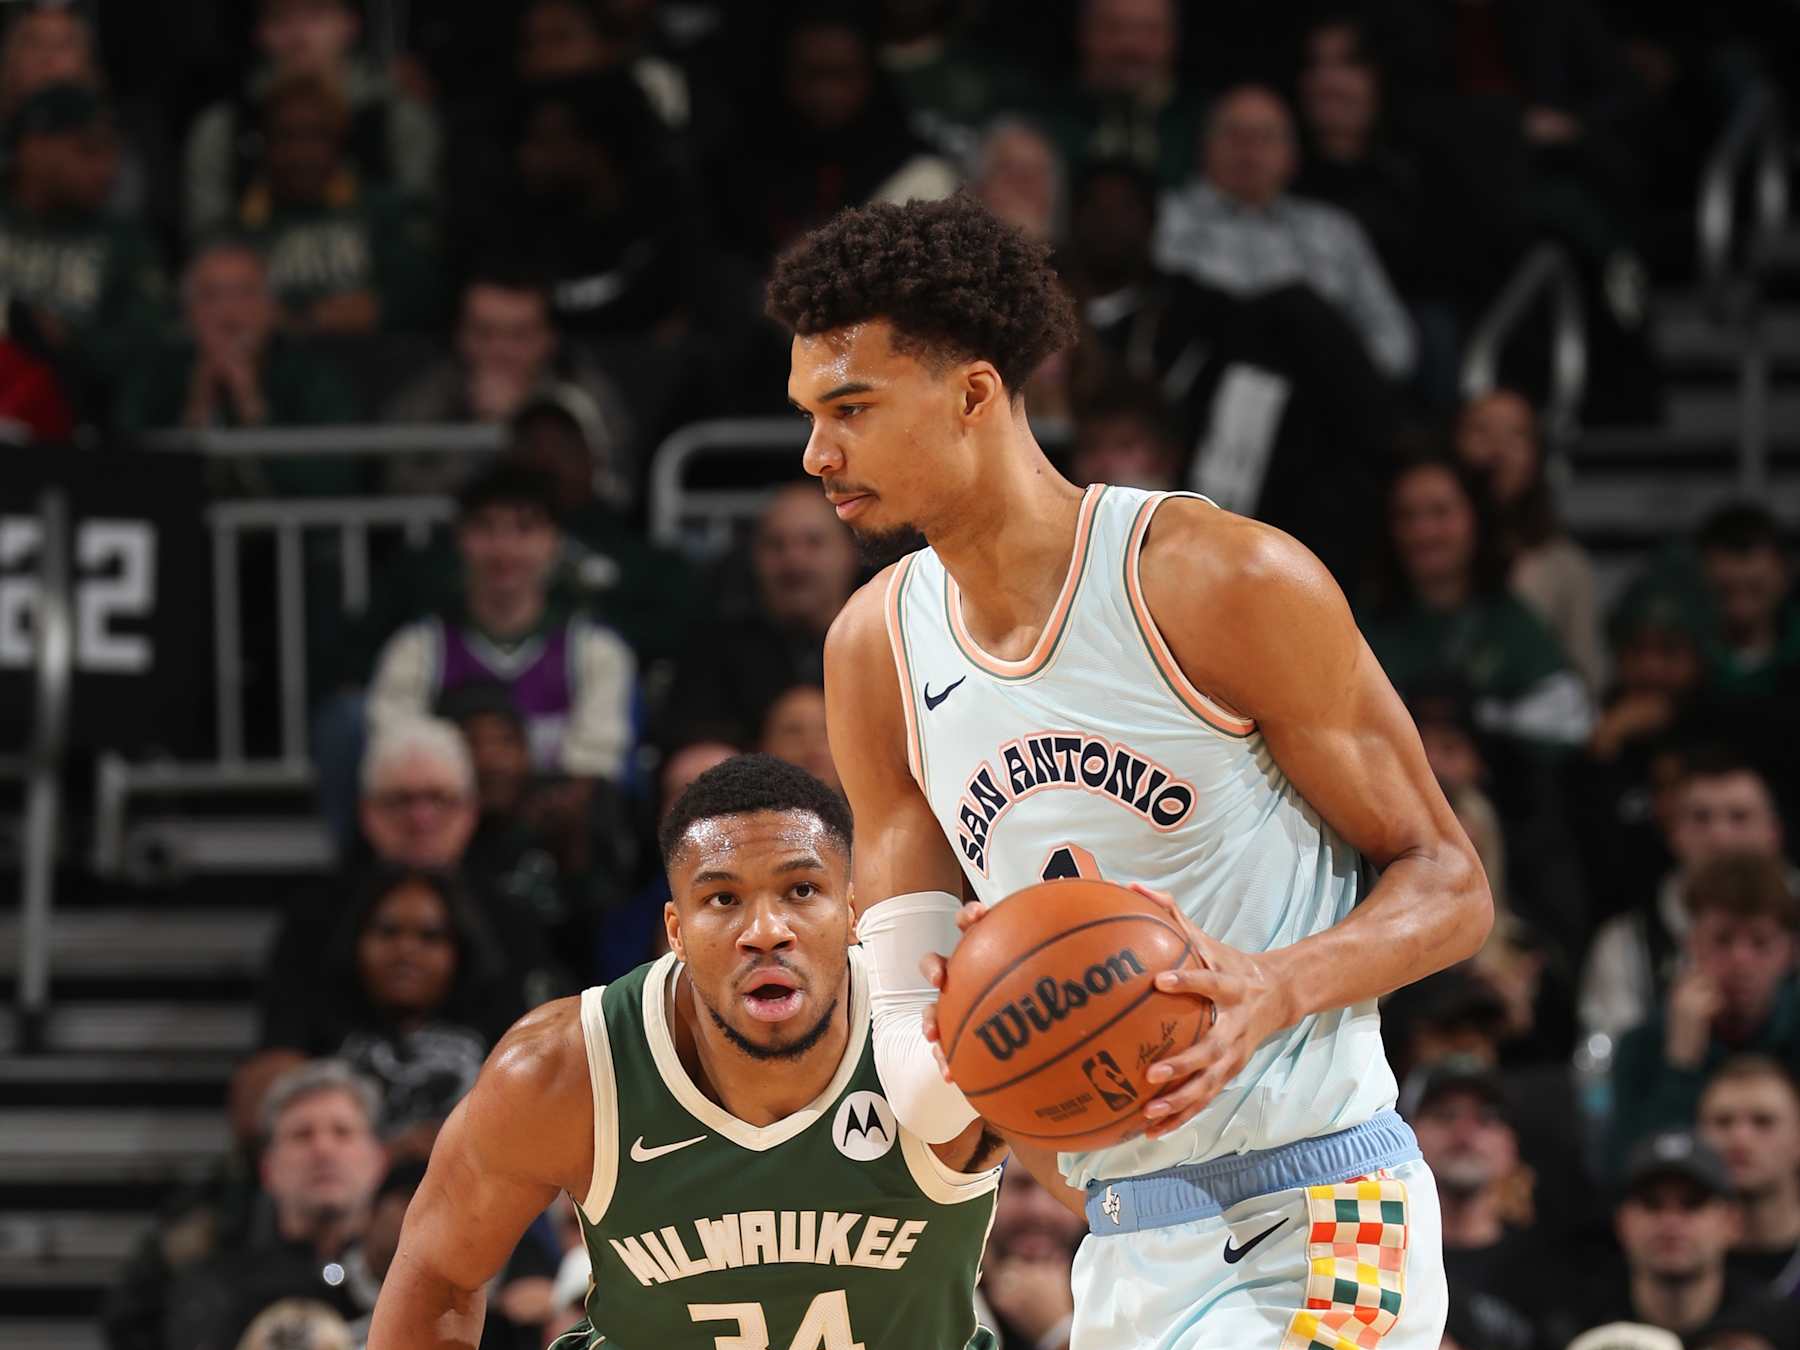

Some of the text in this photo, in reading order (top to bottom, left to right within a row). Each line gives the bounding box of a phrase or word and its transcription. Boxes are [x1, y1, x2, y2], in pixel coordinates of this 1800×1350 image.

[958, 736, 1194, 873] SAN ANTONIO
[974, 948, 1147, 1062] Wilson
[608, 1210, 928, 1287] MILWAUKEE
